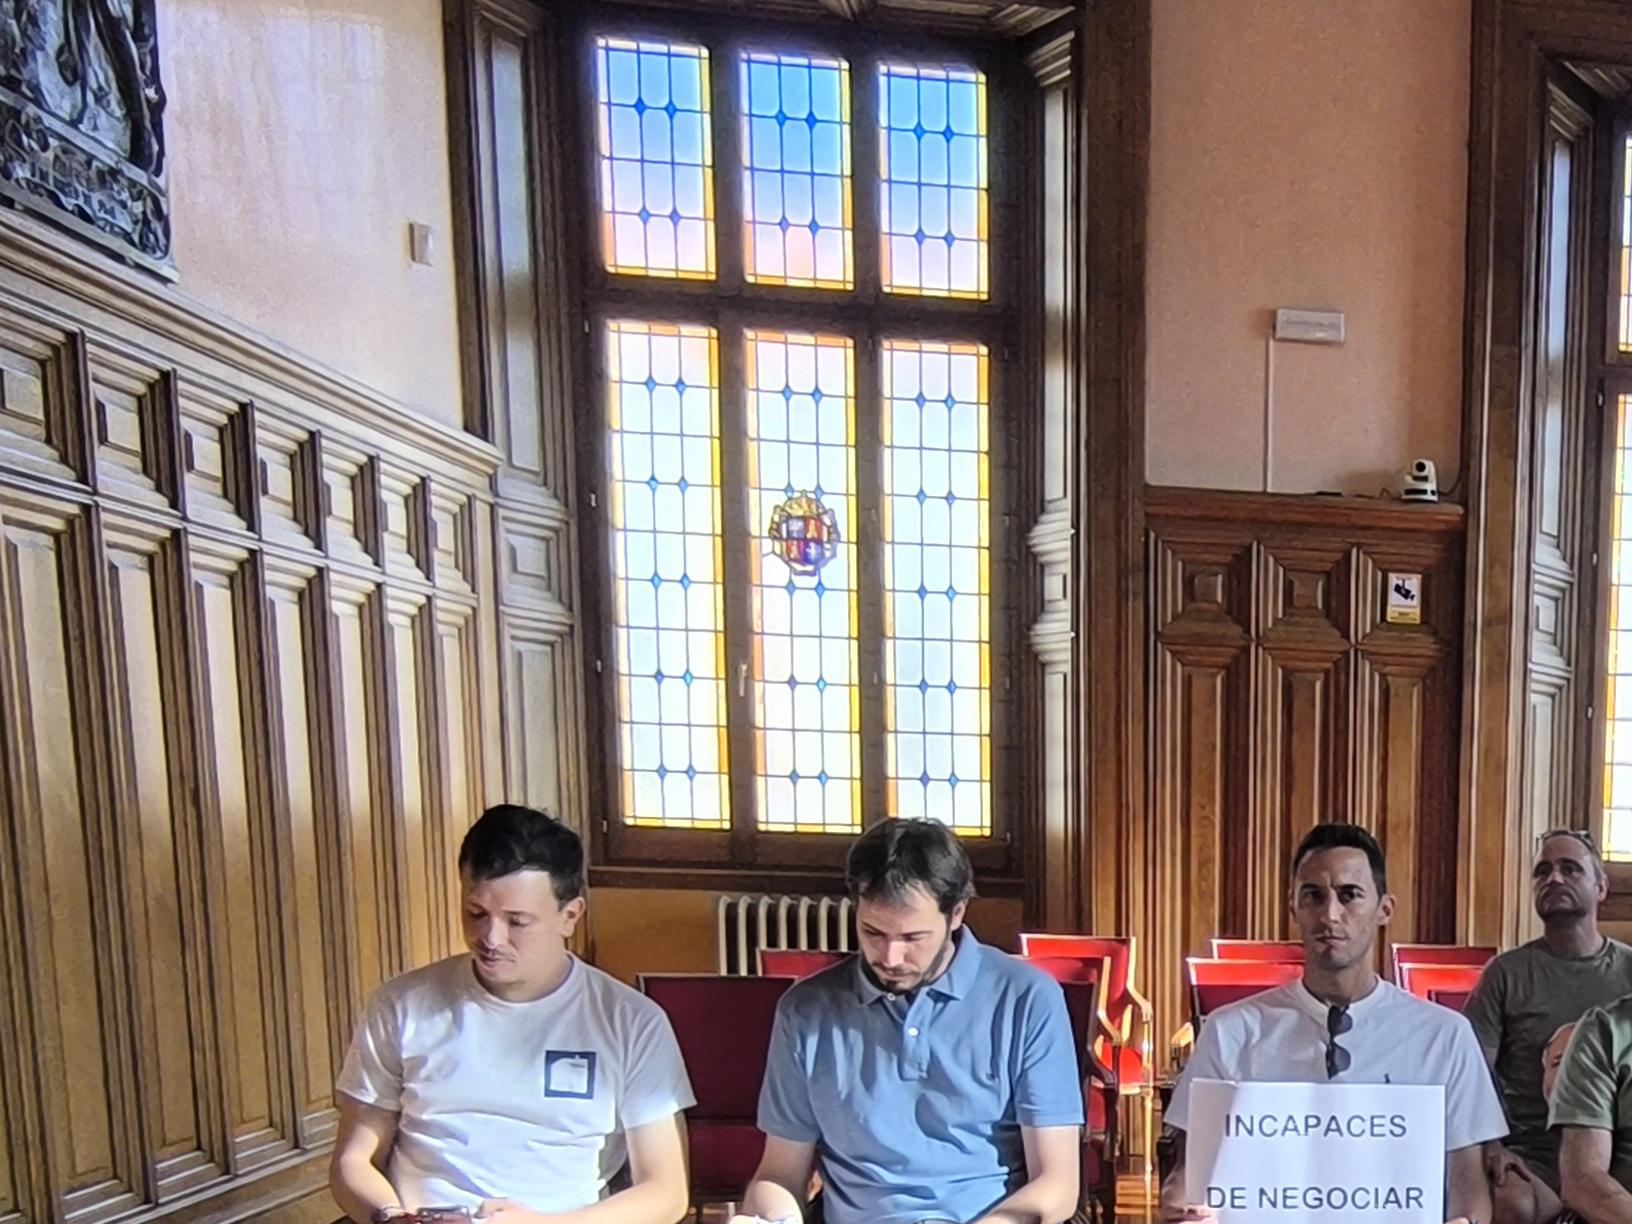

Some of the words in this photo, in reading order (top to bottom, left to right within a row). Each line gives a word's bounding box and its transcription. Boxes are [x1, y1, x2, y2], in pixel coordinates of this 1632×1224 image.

[1225, 1113, 1407, 1138] INCAPACES
[1206, 1186, 1247, 1209] DE
[1259, 1186, 1424, 1209] NEGOCIAR
